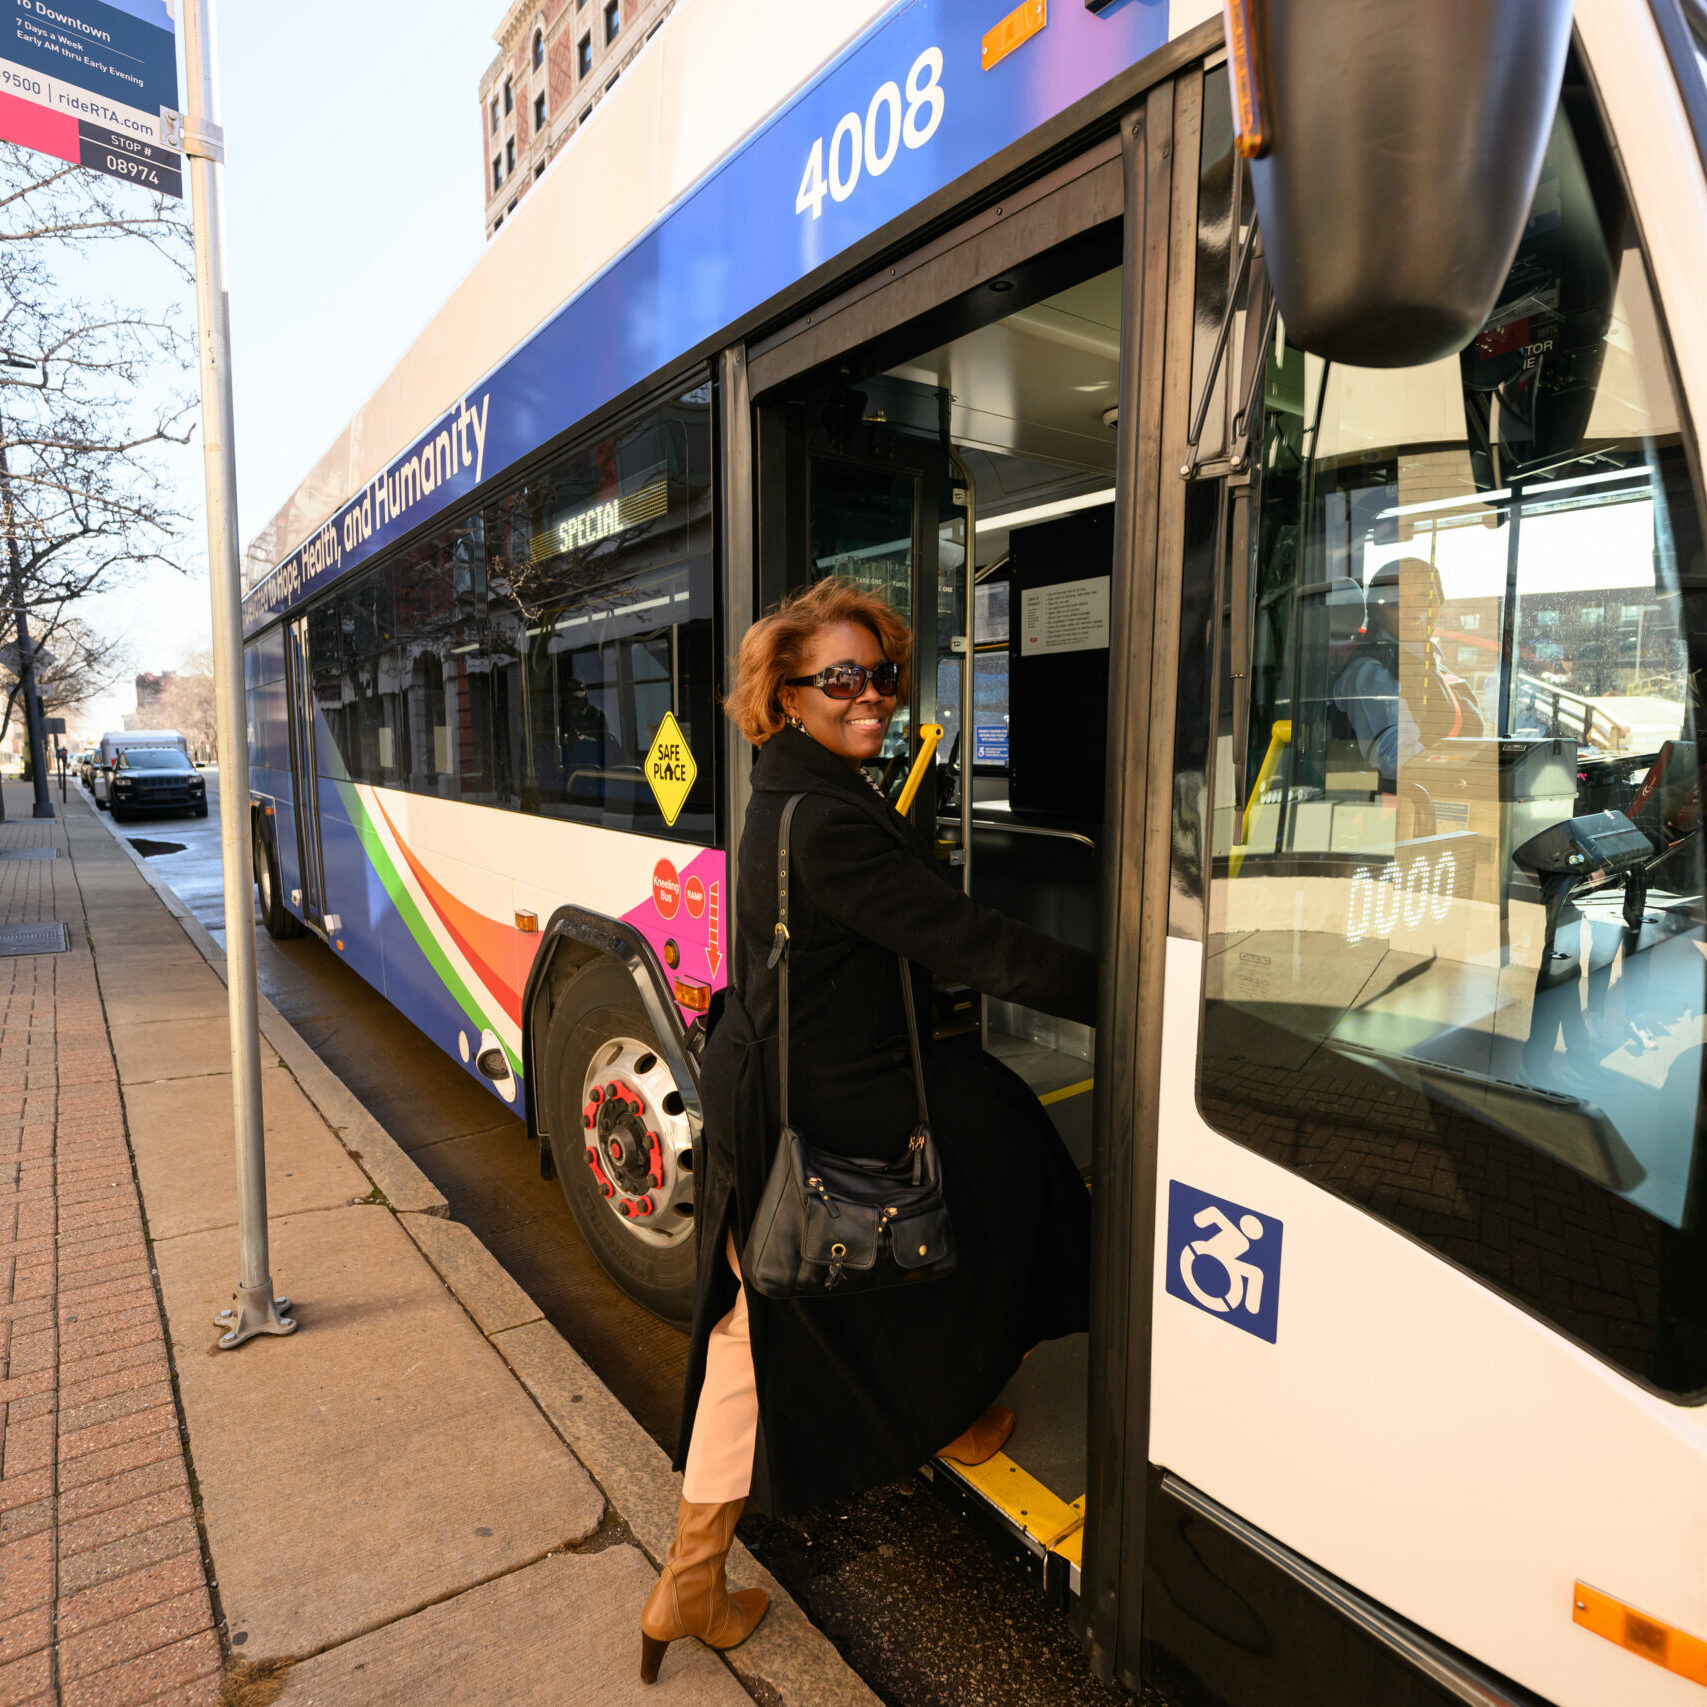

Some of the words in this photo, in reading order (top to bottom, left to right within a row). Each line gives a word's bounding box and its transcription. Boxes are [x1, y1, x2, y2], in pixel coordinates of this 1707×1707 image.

[15, 18, 23, 26] 7
[24, 22, 48, 37] Days
[57, 34, 84, 52] Week
[35, 3, 111, 42] Downtown
[16, 30, 42, 47] Early
[44, 41, 60, 53] AM
[61, 49, 82, 62] thru
[83, 56, 108, 73] Early
[109, 66, 145, 88] Evening
[0, 70, 41, 95] 9500
[58, 93, 154, 137] rideRTA.com
[111, 135, 142, 153] STOP
[144, 147, 152, 157] #
[795, 46, 945, 220] 4008
[106, 155, 160, 185] 08974
[276, 559, 302, 606] Hope,
[301, 523, 342, 568] Health,
[343, 486, 373, 552] and
[375, 393, 490, 530] Humanity
[559, 498, 625, 553] SPECIAL
[658, 744, 680, 761] SAFE
[653, 875, 680, 895] Kneeling
[660, 889, 673, 903] Bus
[687, 890, 703, 902] RAMP
